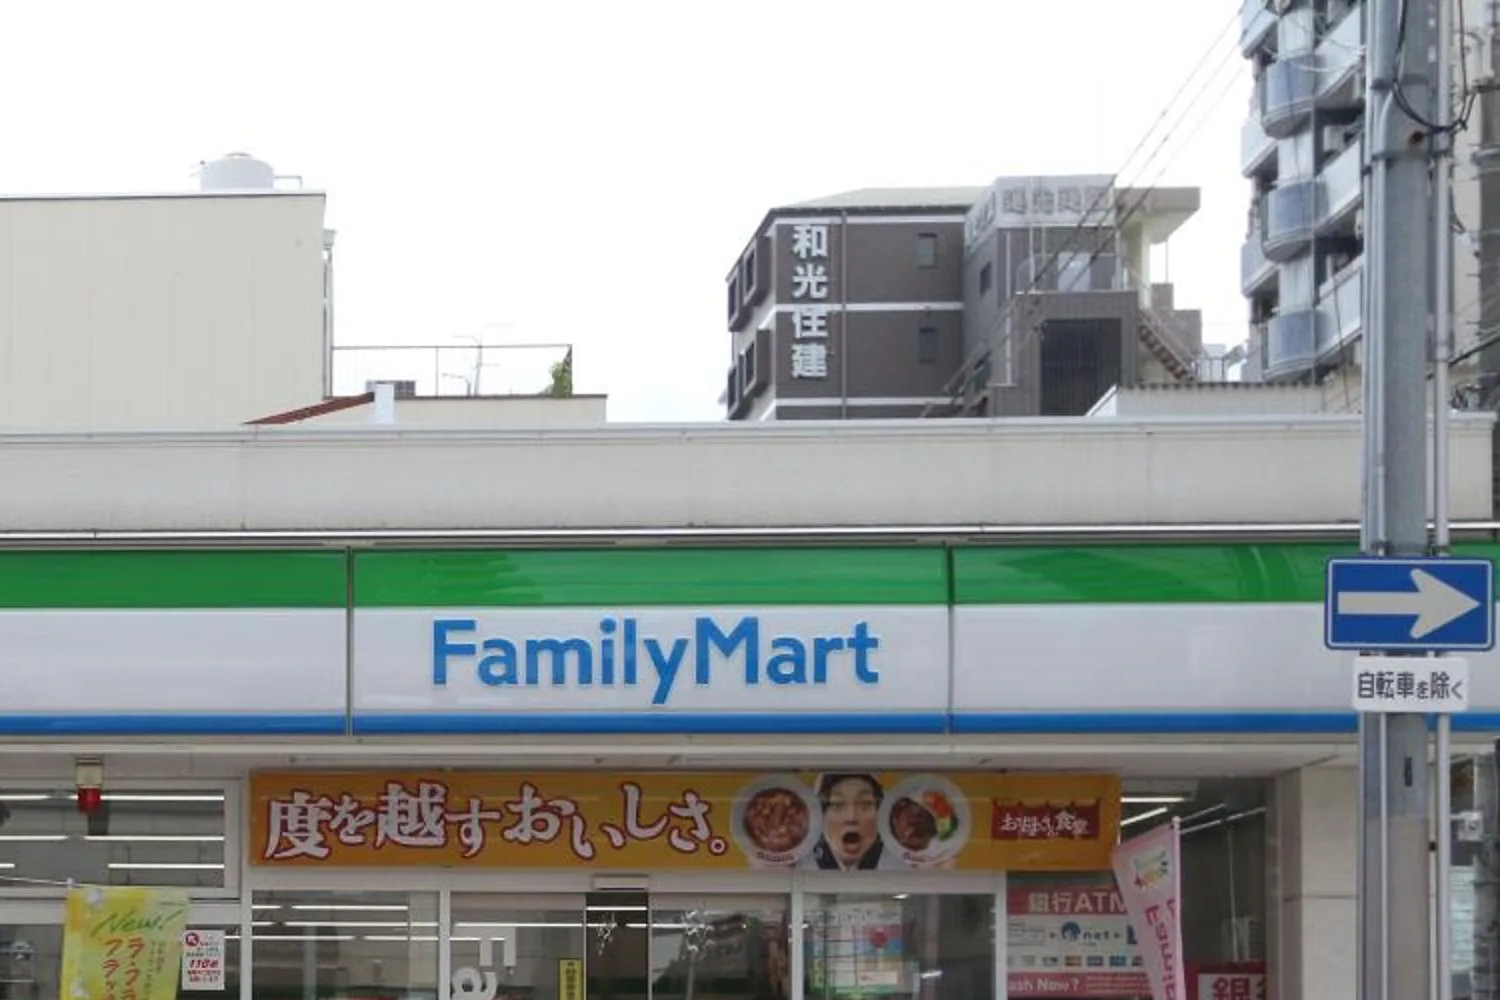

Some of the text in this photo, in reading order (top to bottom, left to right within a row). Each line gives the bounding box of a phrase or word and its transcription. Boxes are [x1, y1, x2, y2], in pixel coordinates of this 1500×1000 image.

[791, 223, 830, 380] 和光住建
[432, 617, 880, 705] FamilyMart
[1357, 671, 1464, 699] 自転車を除く
[265, 779, 728, 859] 度を越すおいしさ。
[91, 909, 184, 938] New!
